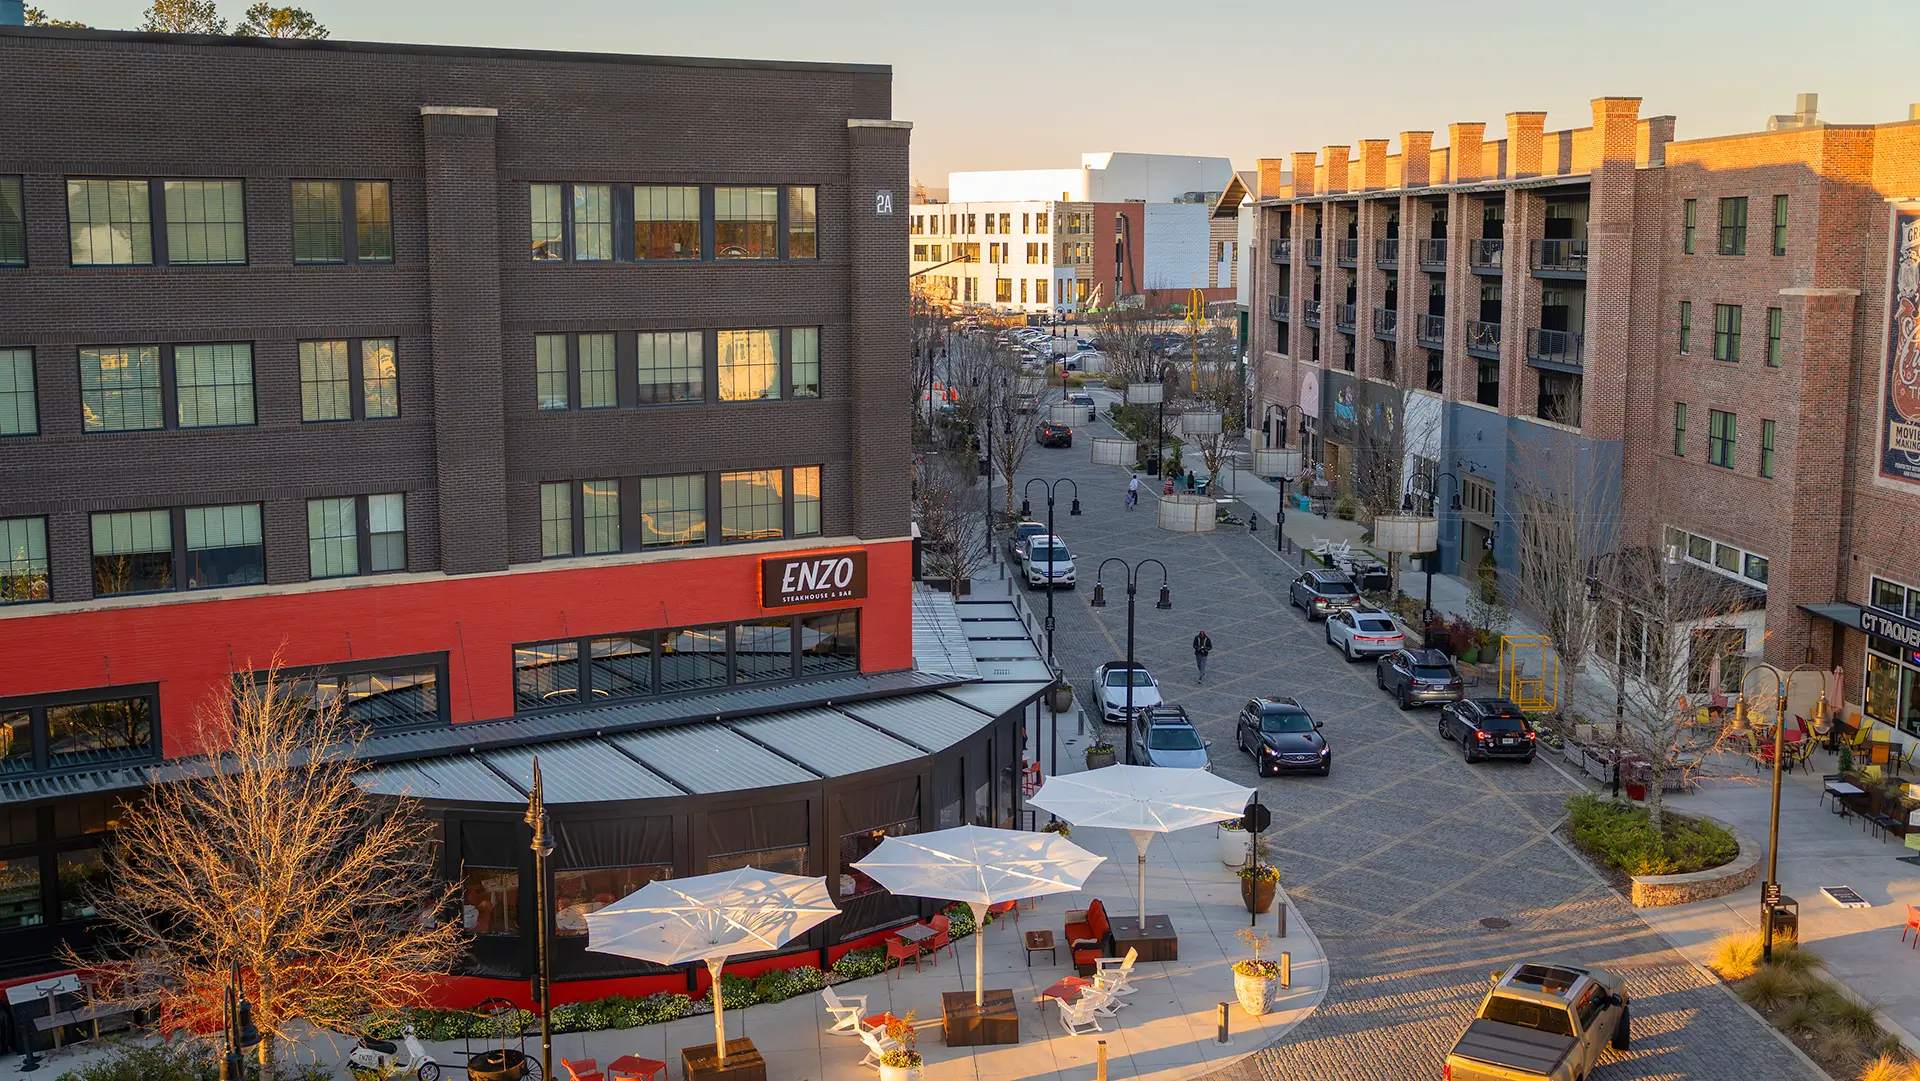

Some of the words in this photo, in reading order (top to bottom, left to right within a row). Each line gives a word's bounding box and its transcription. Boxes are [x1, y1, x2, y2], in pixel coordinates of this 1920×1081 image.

[876, 195, 893, 212] 2A
[1907, 225, 1920, 242] GR
[781, 557, 854, 593] ENZO
[782, 592, 828, 603] STEAKHOUSE
[1861, 612, 1878, 632] CT
